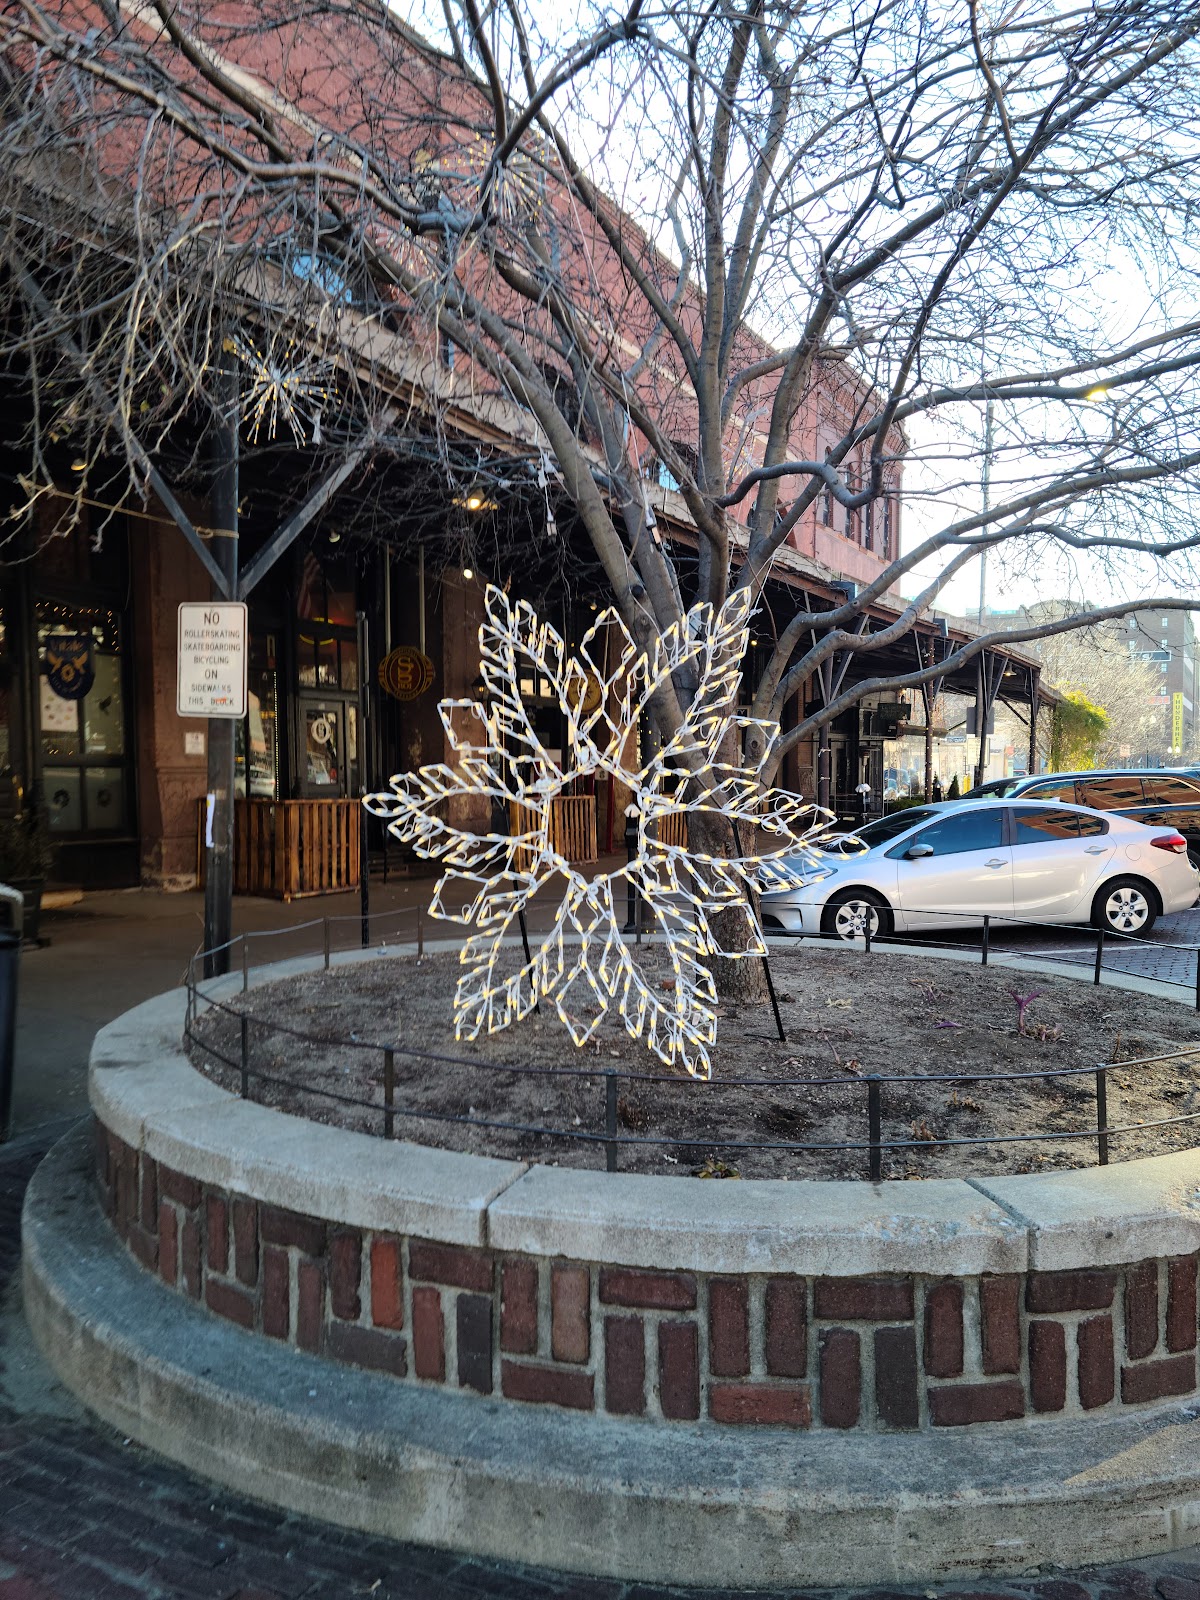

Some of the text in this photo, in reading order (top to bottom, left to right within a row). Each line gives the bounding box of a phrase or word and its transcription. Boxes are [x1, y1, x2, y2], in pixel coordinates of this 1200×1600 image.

[204, 612, 220, 625] NO
[184, 629, 240, 639] ROLLERSKATING
[183, 642, 241, 652] SKATEBOARDING
[193, 655, 229, 665] BICYCLING
[204, 669, 218, 680] ON
[188, 696, 204, 705] THIS
